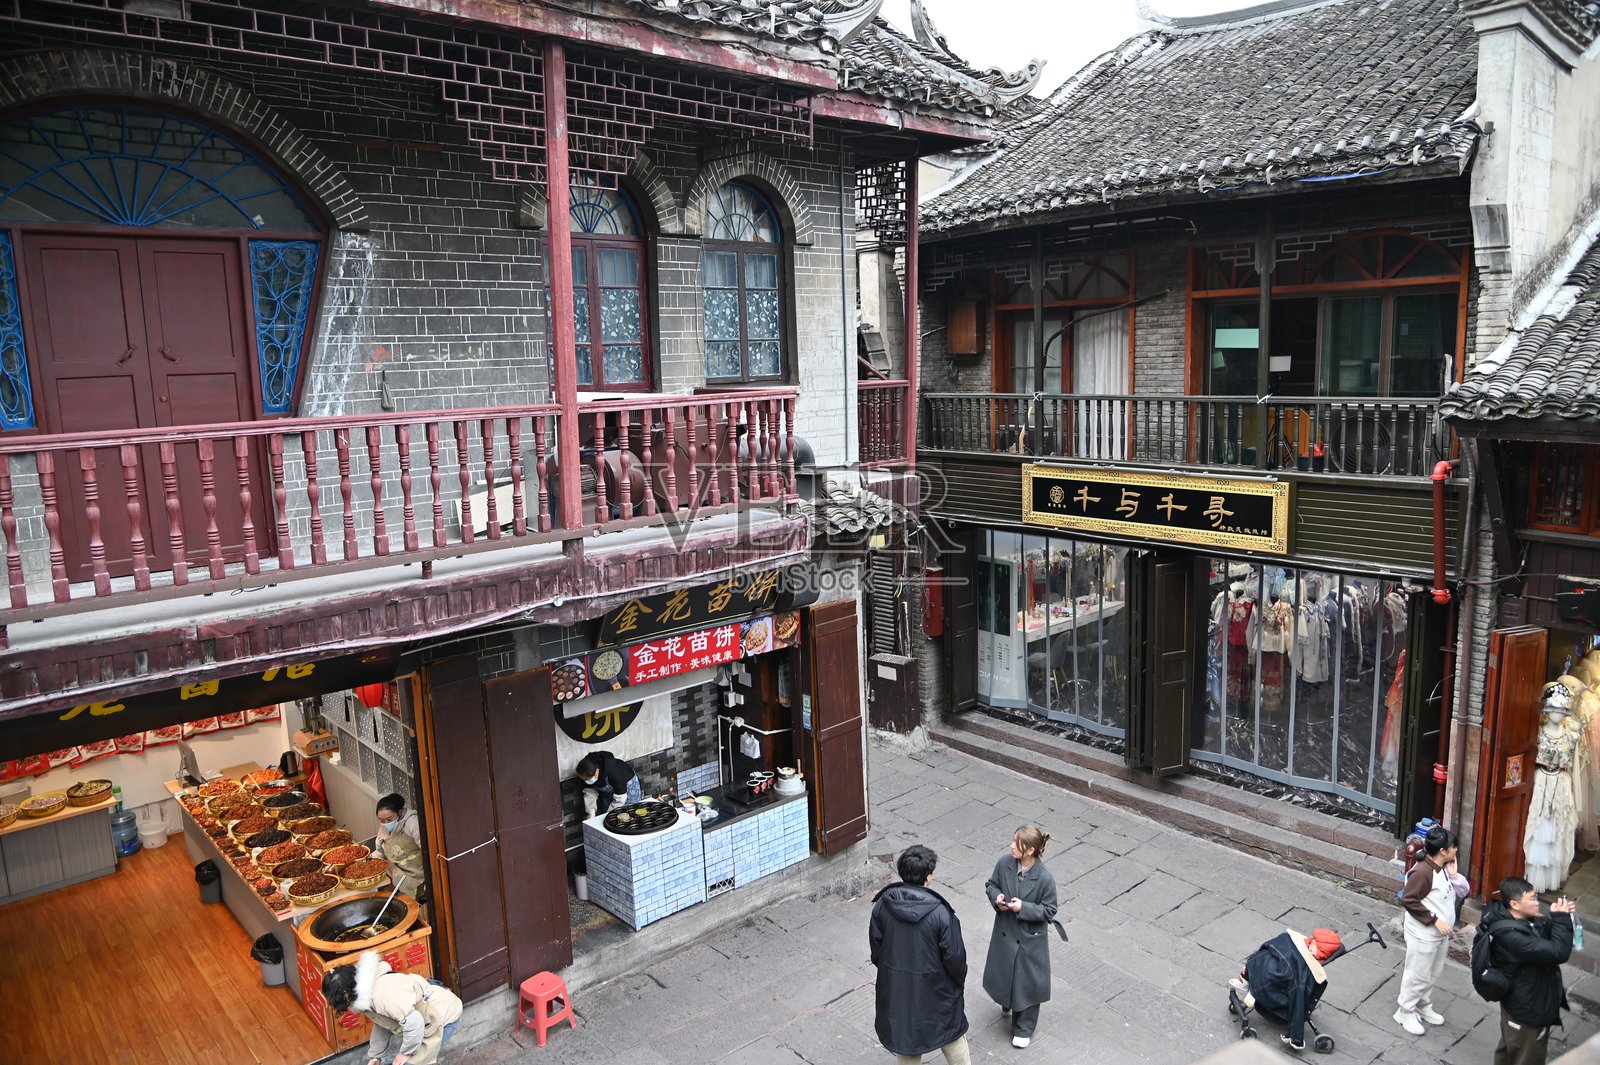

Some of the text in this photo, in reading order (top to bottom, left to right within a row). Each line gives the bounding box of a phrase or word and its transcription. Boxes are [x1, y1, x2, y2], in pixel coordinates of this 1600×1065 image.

[1073, 485, 1235, 528] 千与千寻
[610, 569, 780, 635] 金花苗饼
[633, 624, 736, 668] 金花苗饼
